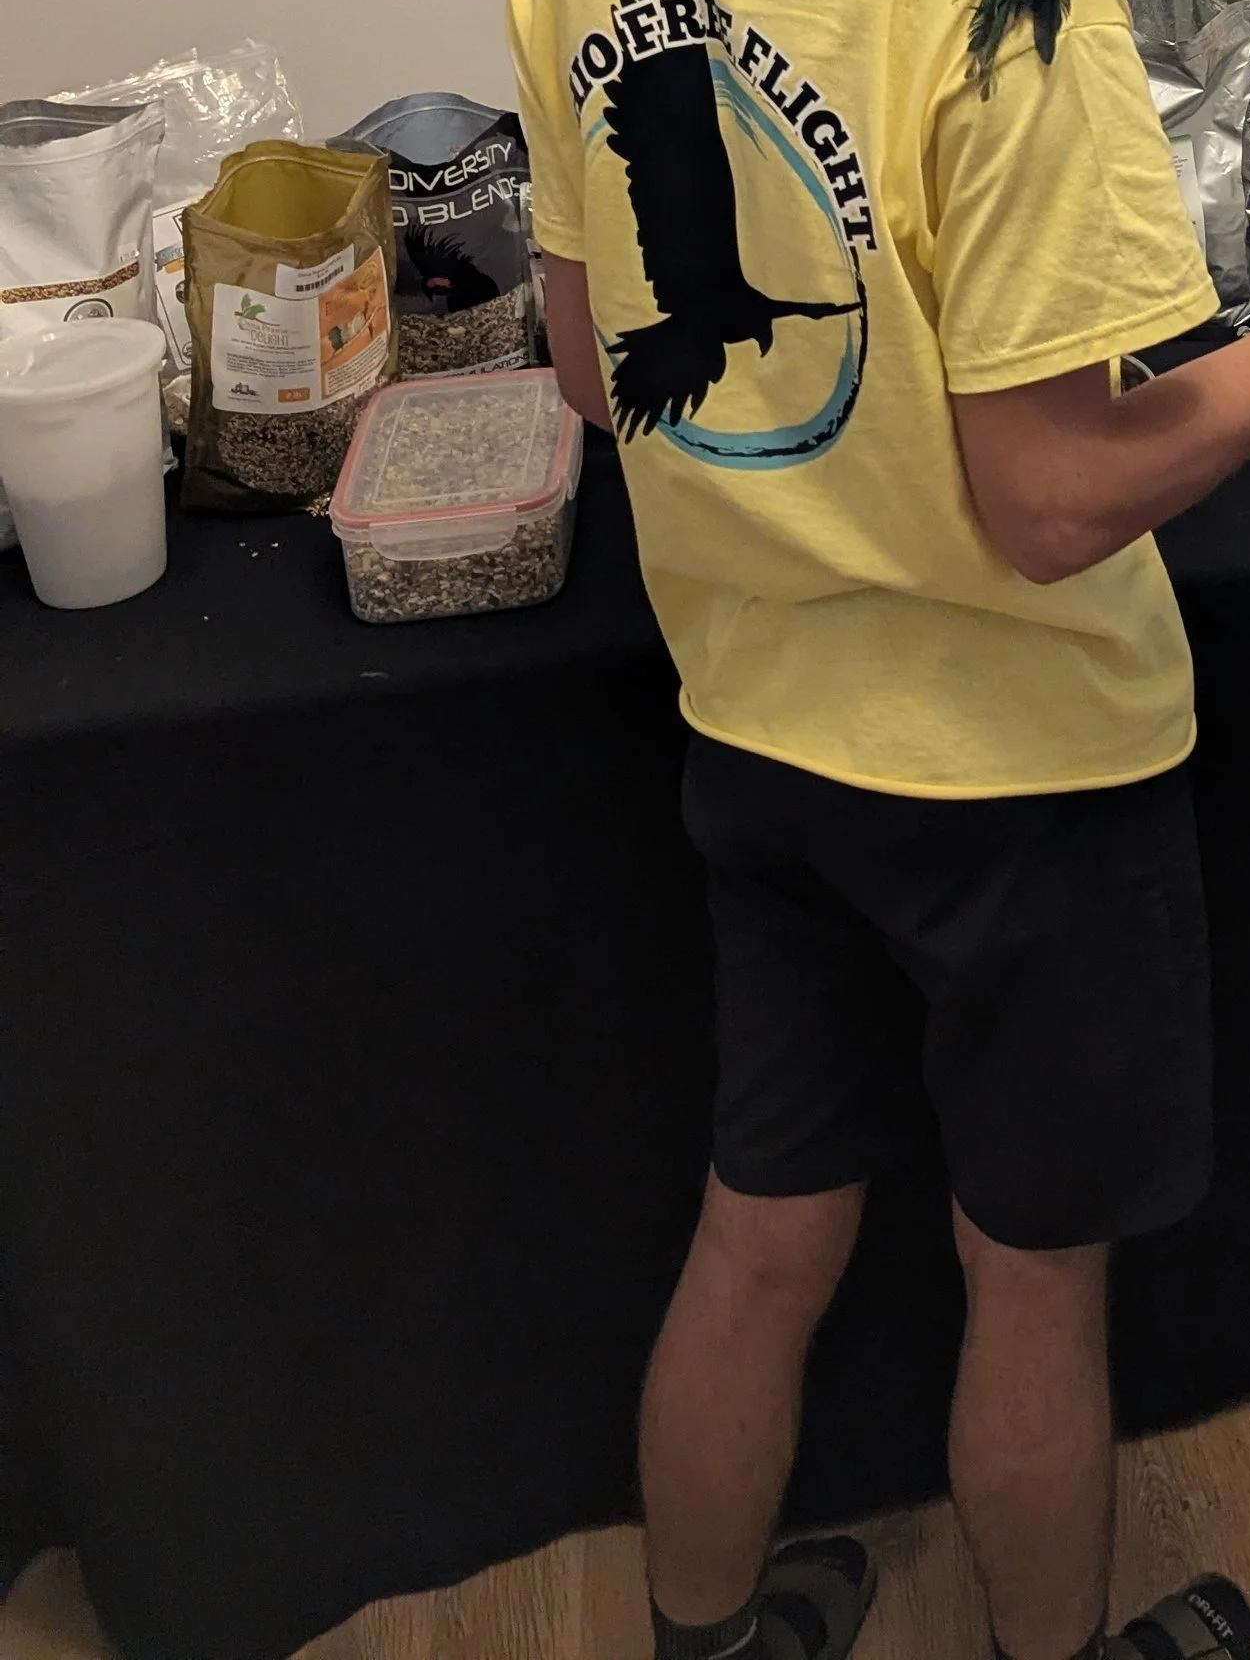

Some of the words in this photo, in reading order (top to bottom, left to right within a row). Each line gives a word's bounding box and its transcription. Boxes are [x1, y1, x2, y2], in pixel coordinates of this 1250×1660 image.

[738, 26, 878, 251] FLIGHT
[387, 141, 513, 192] DIVERSITY
[416, 176, 522, 227] BLENDS
